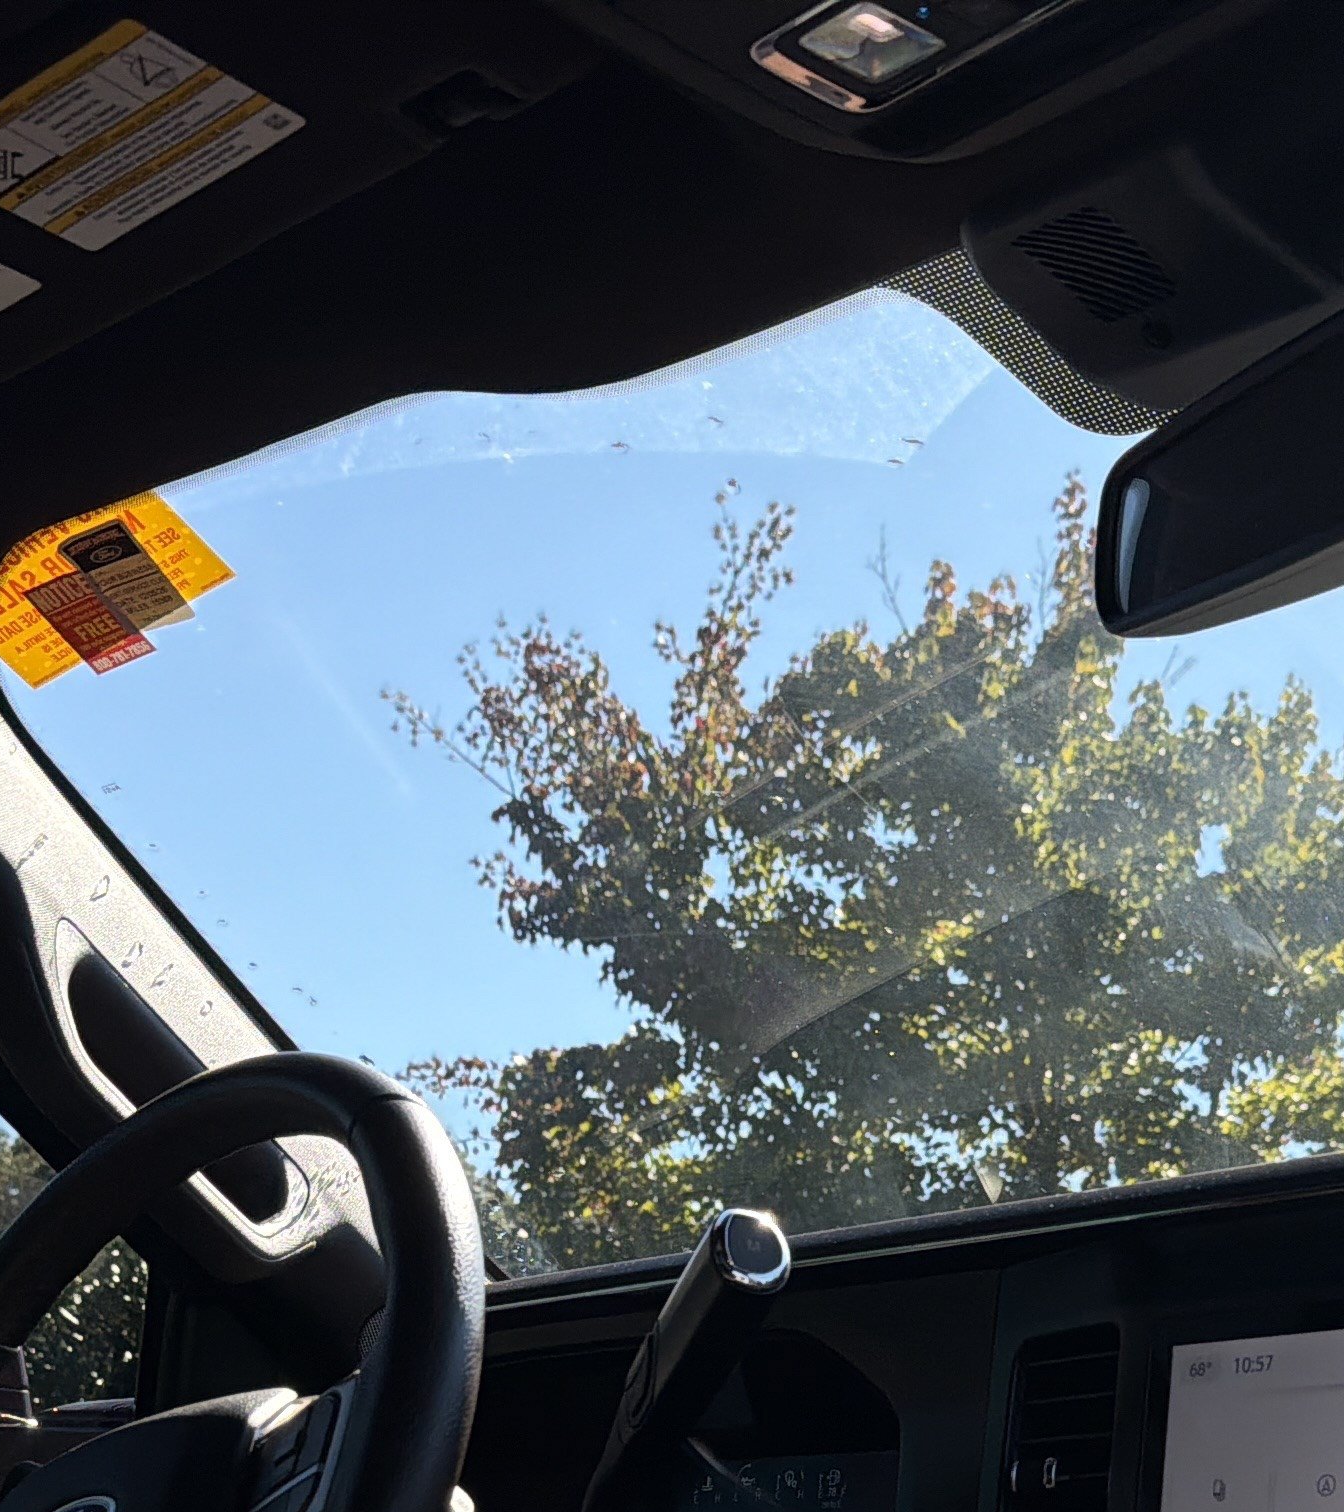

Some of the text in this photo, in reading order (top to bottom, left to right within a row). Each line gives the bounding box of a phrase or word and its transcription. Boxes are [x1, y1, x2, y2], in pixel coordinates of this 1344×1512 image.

[28, 571, 96, 613] NOTICE
[74, 613, 124, 642] FREE
[1234, 1355, 1273, 1374] 10:57
